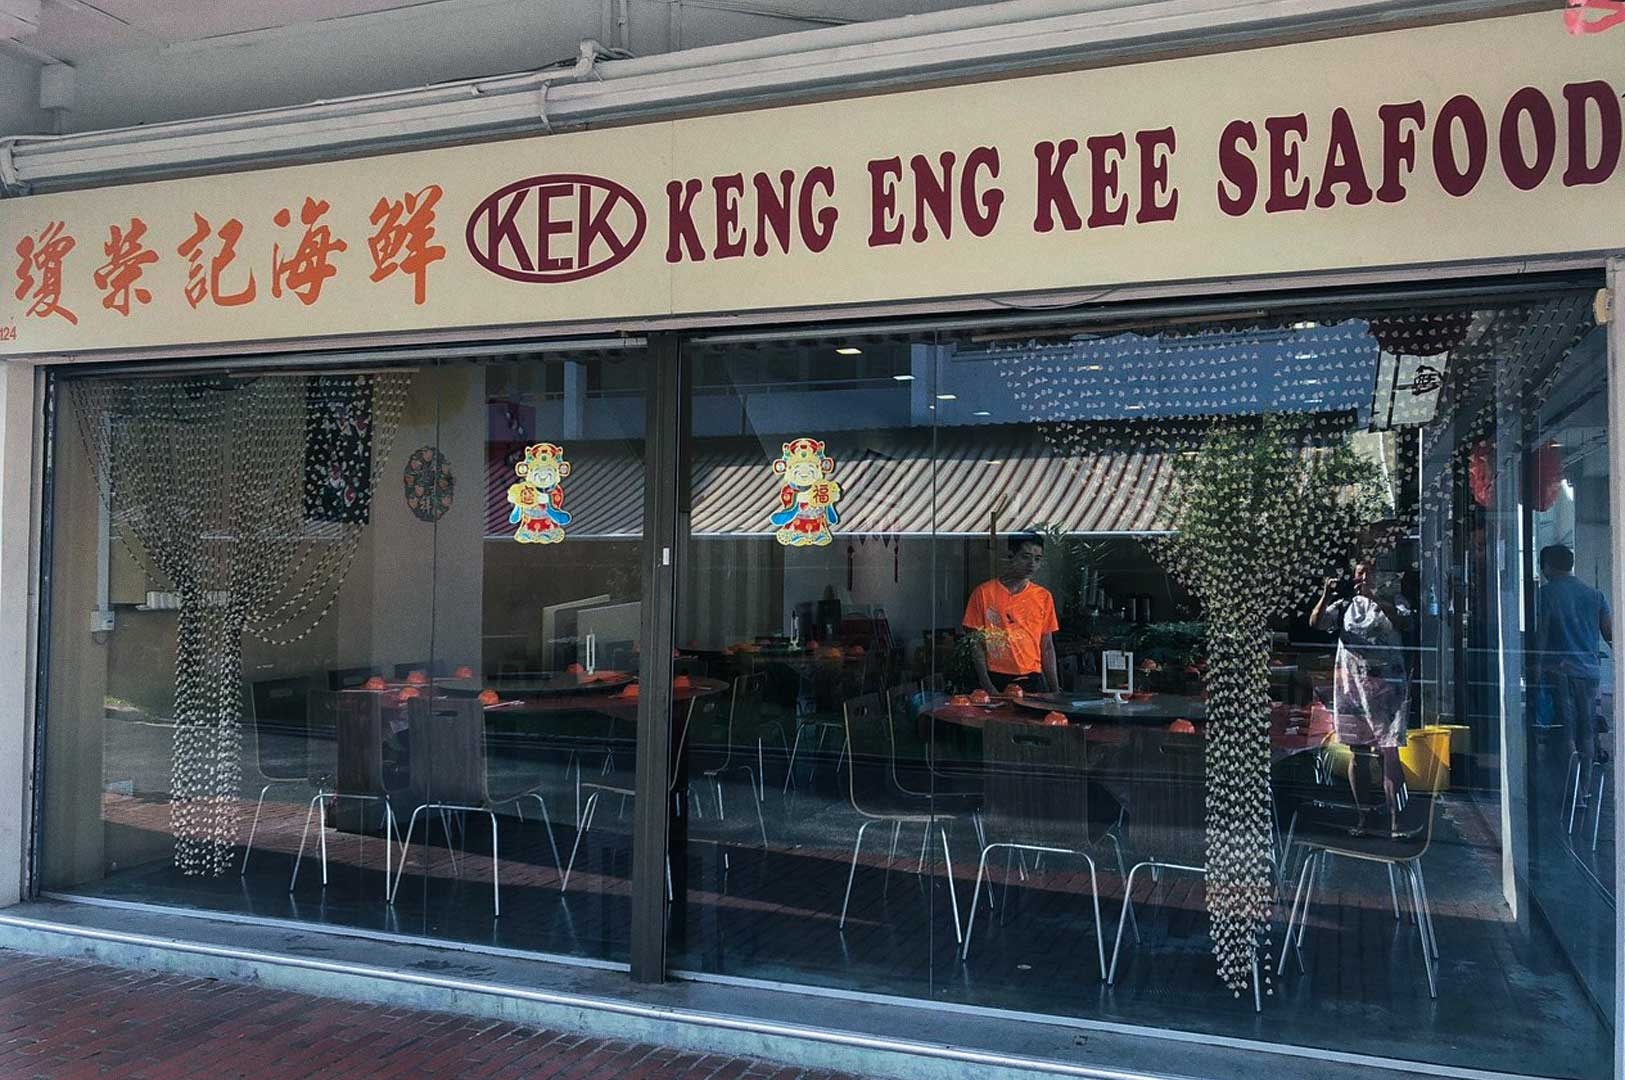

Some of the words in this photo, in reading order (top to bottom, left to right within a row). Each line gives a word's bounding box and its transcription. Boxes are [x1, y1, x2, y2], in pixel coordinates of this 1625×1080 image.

[665, 165, 839, 264] KENG
[867, 146, 1005, 248] ENG
[1033, 126, 1179, 233] KEE
[1217, 80, 1622, 217] SEAFOOD
[486, 182, 628, 273] KEK
[812, 483, 829, 504] 福
